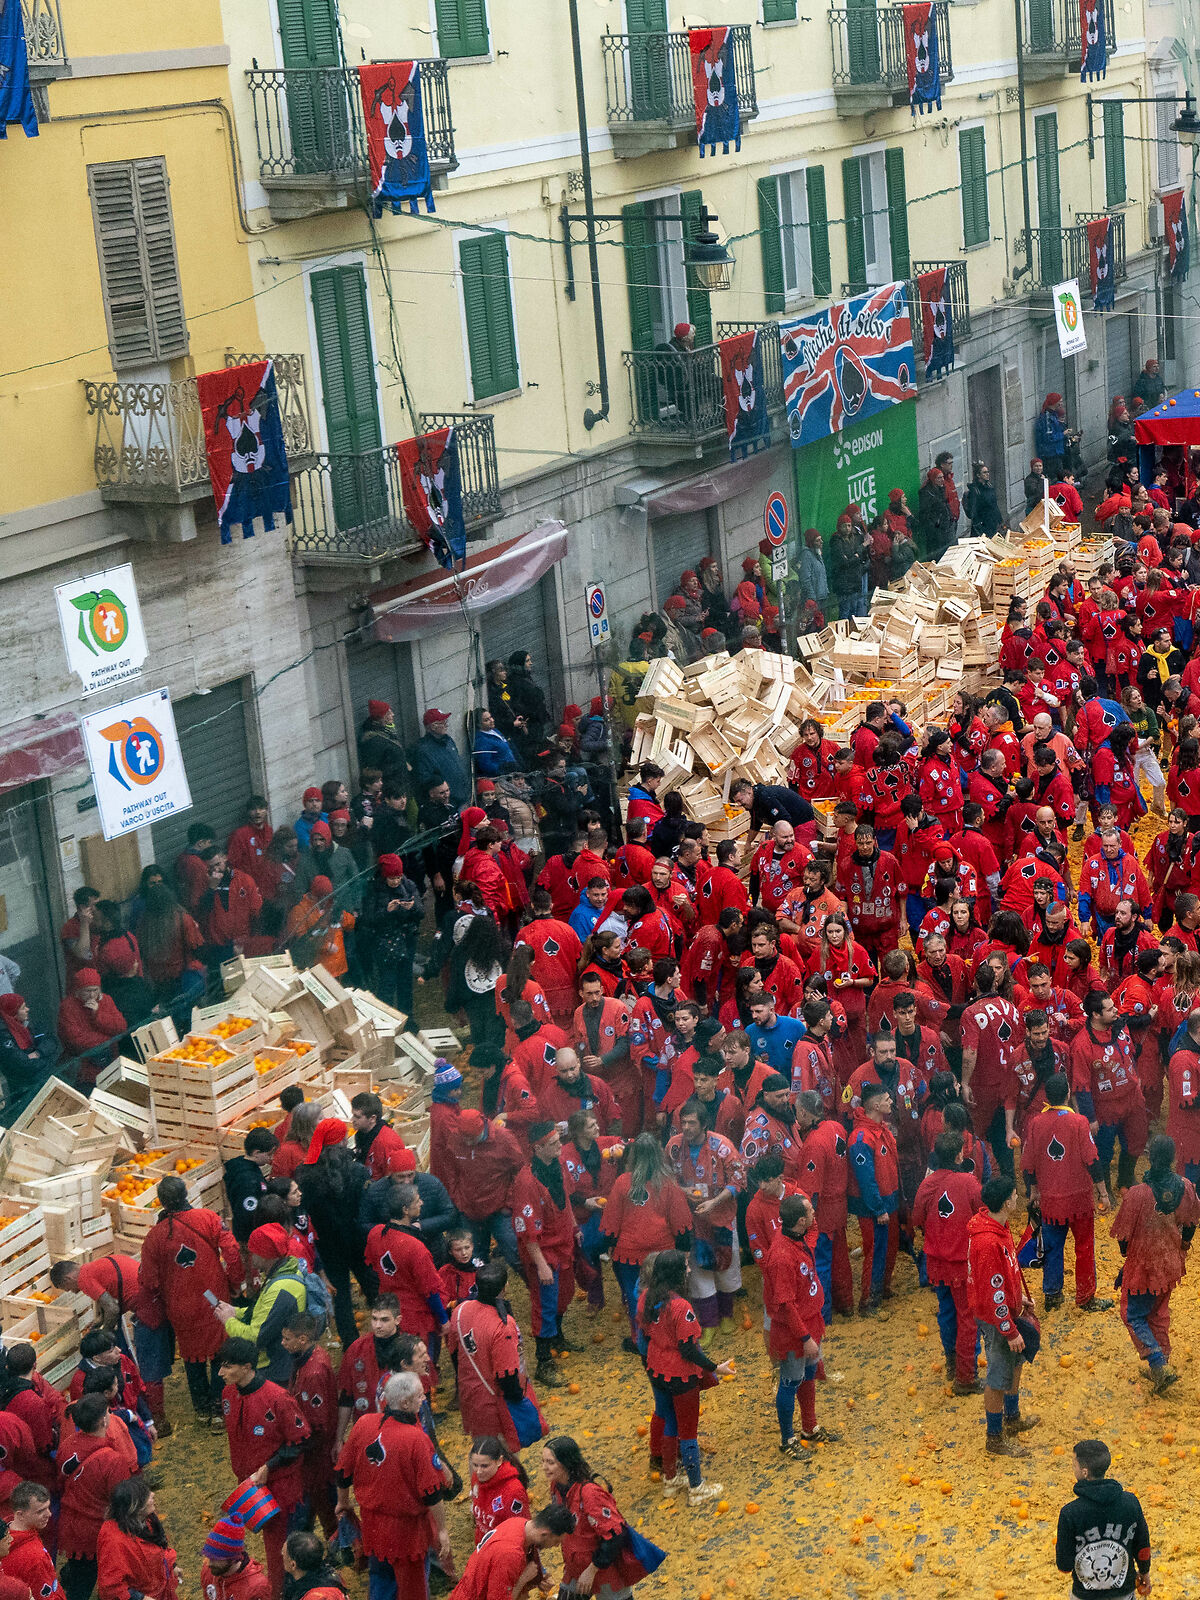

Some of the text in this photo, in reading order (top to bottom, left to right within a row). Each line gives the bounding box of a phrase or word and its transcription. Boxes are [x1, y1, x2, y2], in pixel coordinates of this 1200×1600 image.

[838, 310, 852, 342] di
[847, 474, 877, 505] LUCE
[860, 497, 879, 525] AS
[91, 658, 131, 679] PATHWAY OUT
[97, 664, 144, 688] ALLONTANAMEN
[122, 791, 168, 816] PATHWAY OUT
[120, 812, 144, 828] VARCO
